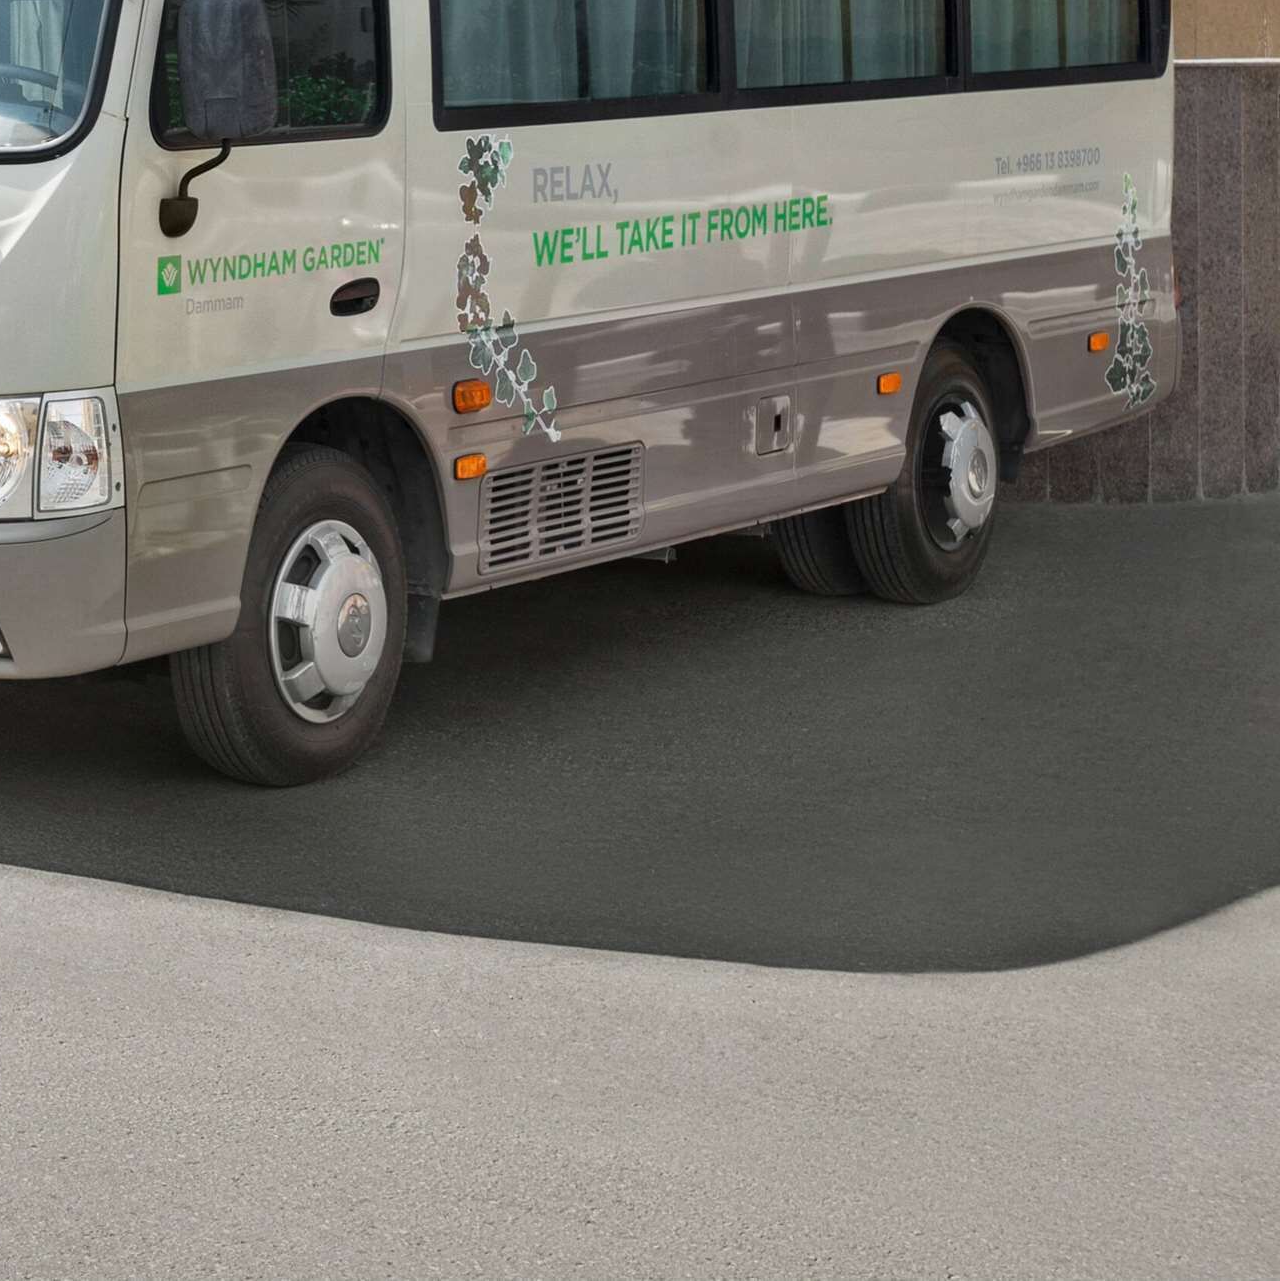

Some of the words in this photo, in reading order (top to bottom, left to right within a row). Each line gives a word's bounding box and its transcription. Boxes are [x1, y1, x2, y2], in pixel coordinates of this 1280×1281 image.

[532, 163, 619, 205] RELAX,
[532, 224, 608, 268] WE'LL
[615, 215, 674, 256] TAKE
[681, 212, 701, 247] IT
[706, 203, 768, 243] FROM
[774, 194, 833, 234] HERE.
[187, 249, 297, 286] WYNDHAM
[302, 239, 381, 272] GARDEN
[185, 295, 245, 316] Dammam
